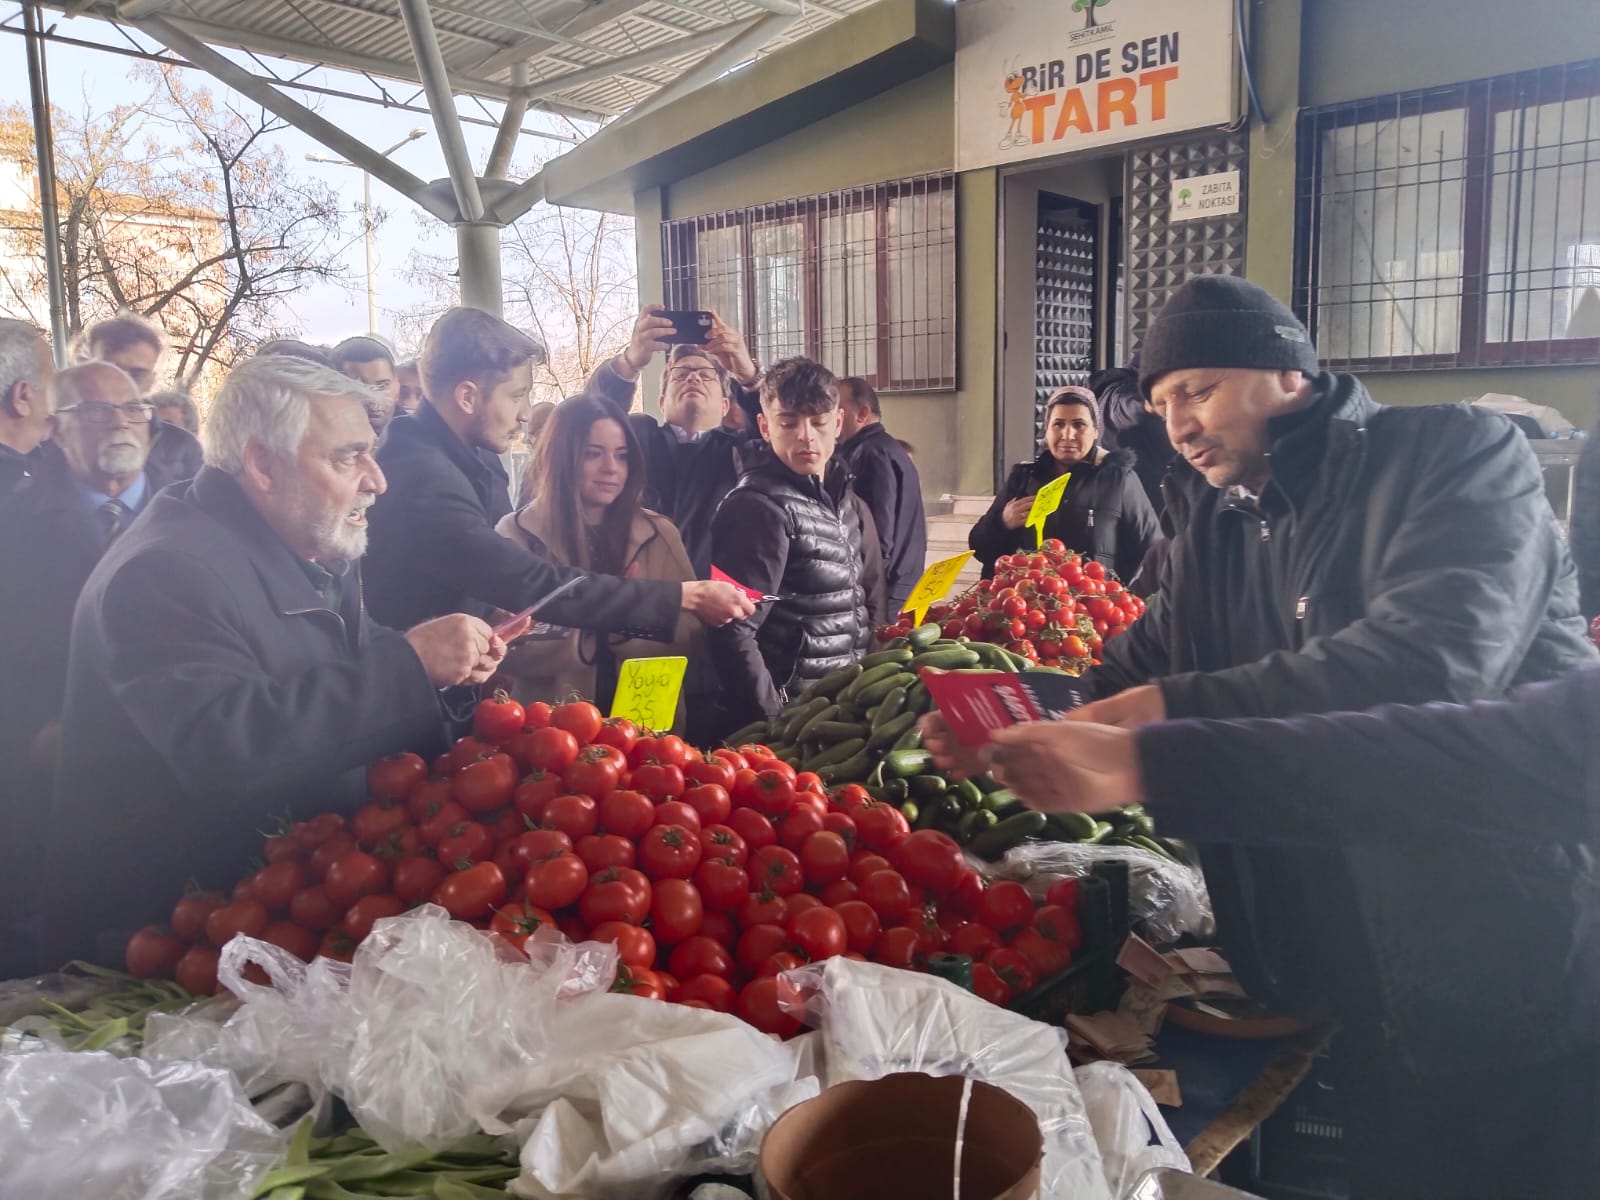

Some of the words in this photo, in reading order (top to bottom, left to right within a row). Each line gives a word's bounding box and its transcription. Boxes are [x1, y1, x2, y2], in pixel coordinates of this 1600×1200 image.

[1075, 48, 1111, 84] DE
[1121, 31, 1180, 73] SEN
[1023, 66, 1179, 145] TART
[1198, 195, 1236, 209] NOKTASI
[1202, 181, 1233, 195] ZABITA
